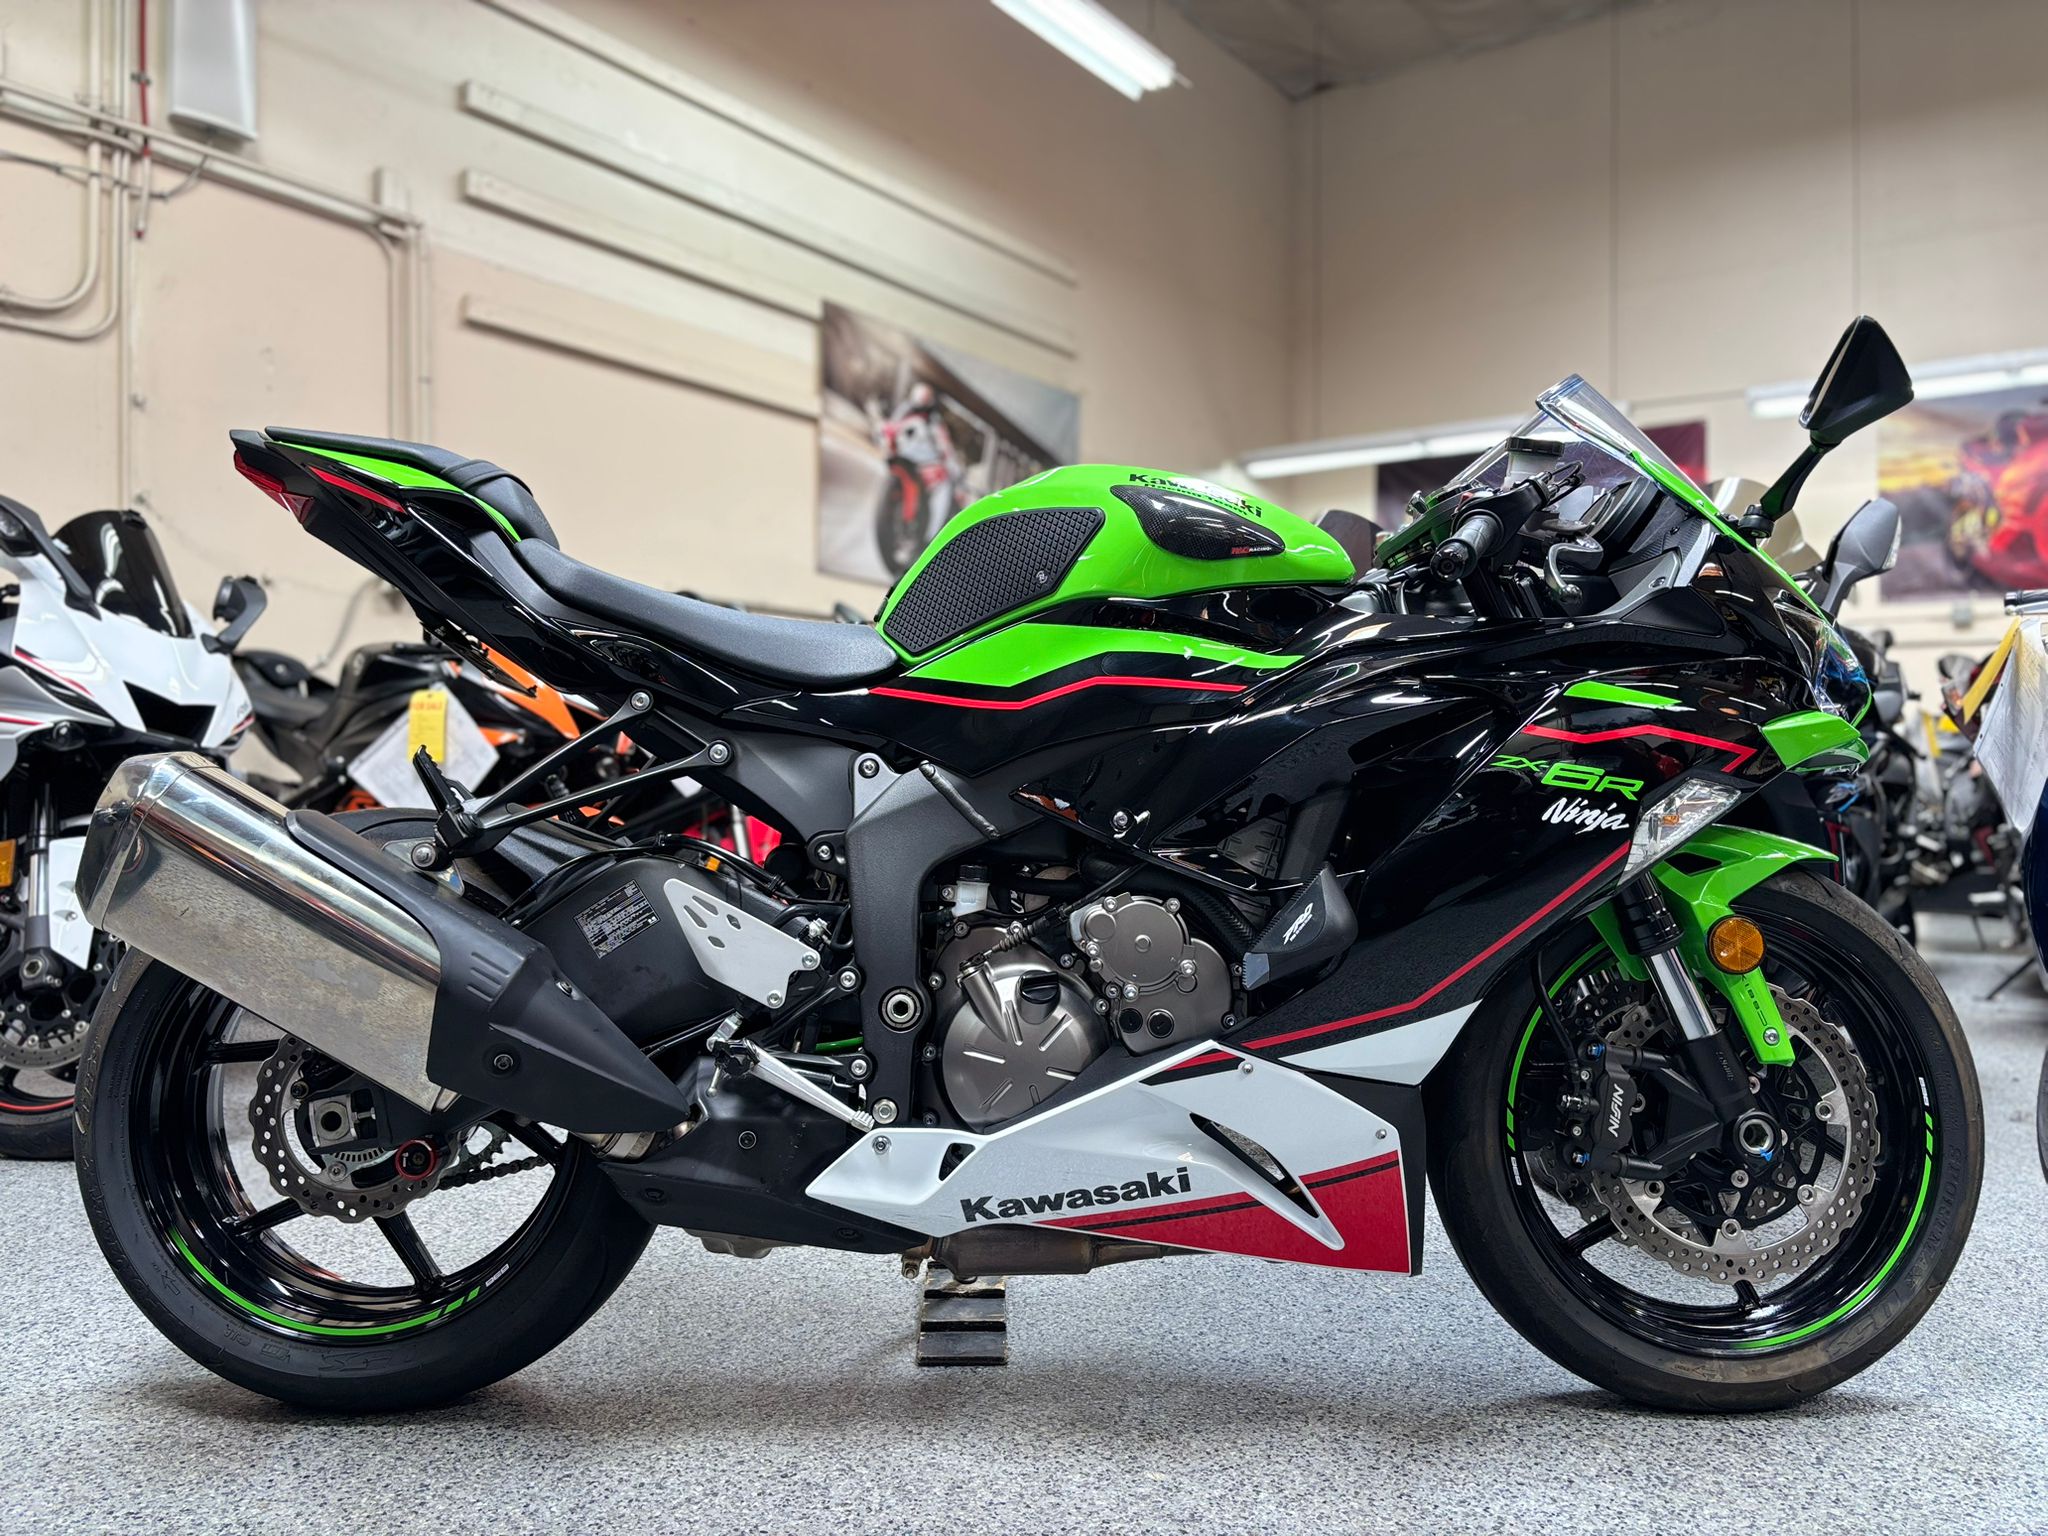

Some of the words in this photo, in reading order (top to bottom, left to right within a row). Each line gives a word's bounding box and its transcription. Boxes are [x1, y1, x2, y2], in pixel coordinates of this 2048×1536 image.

[1129, 473, 1263, 518] Kawaki
[1490, 754, 1645, 801] ZX-6R
[1541, 796, 1630, 836] Ninja
[1607, 1083, 1625, 1138] NISSIN
[959, 1166, 1192, 1223] Kawasaki
